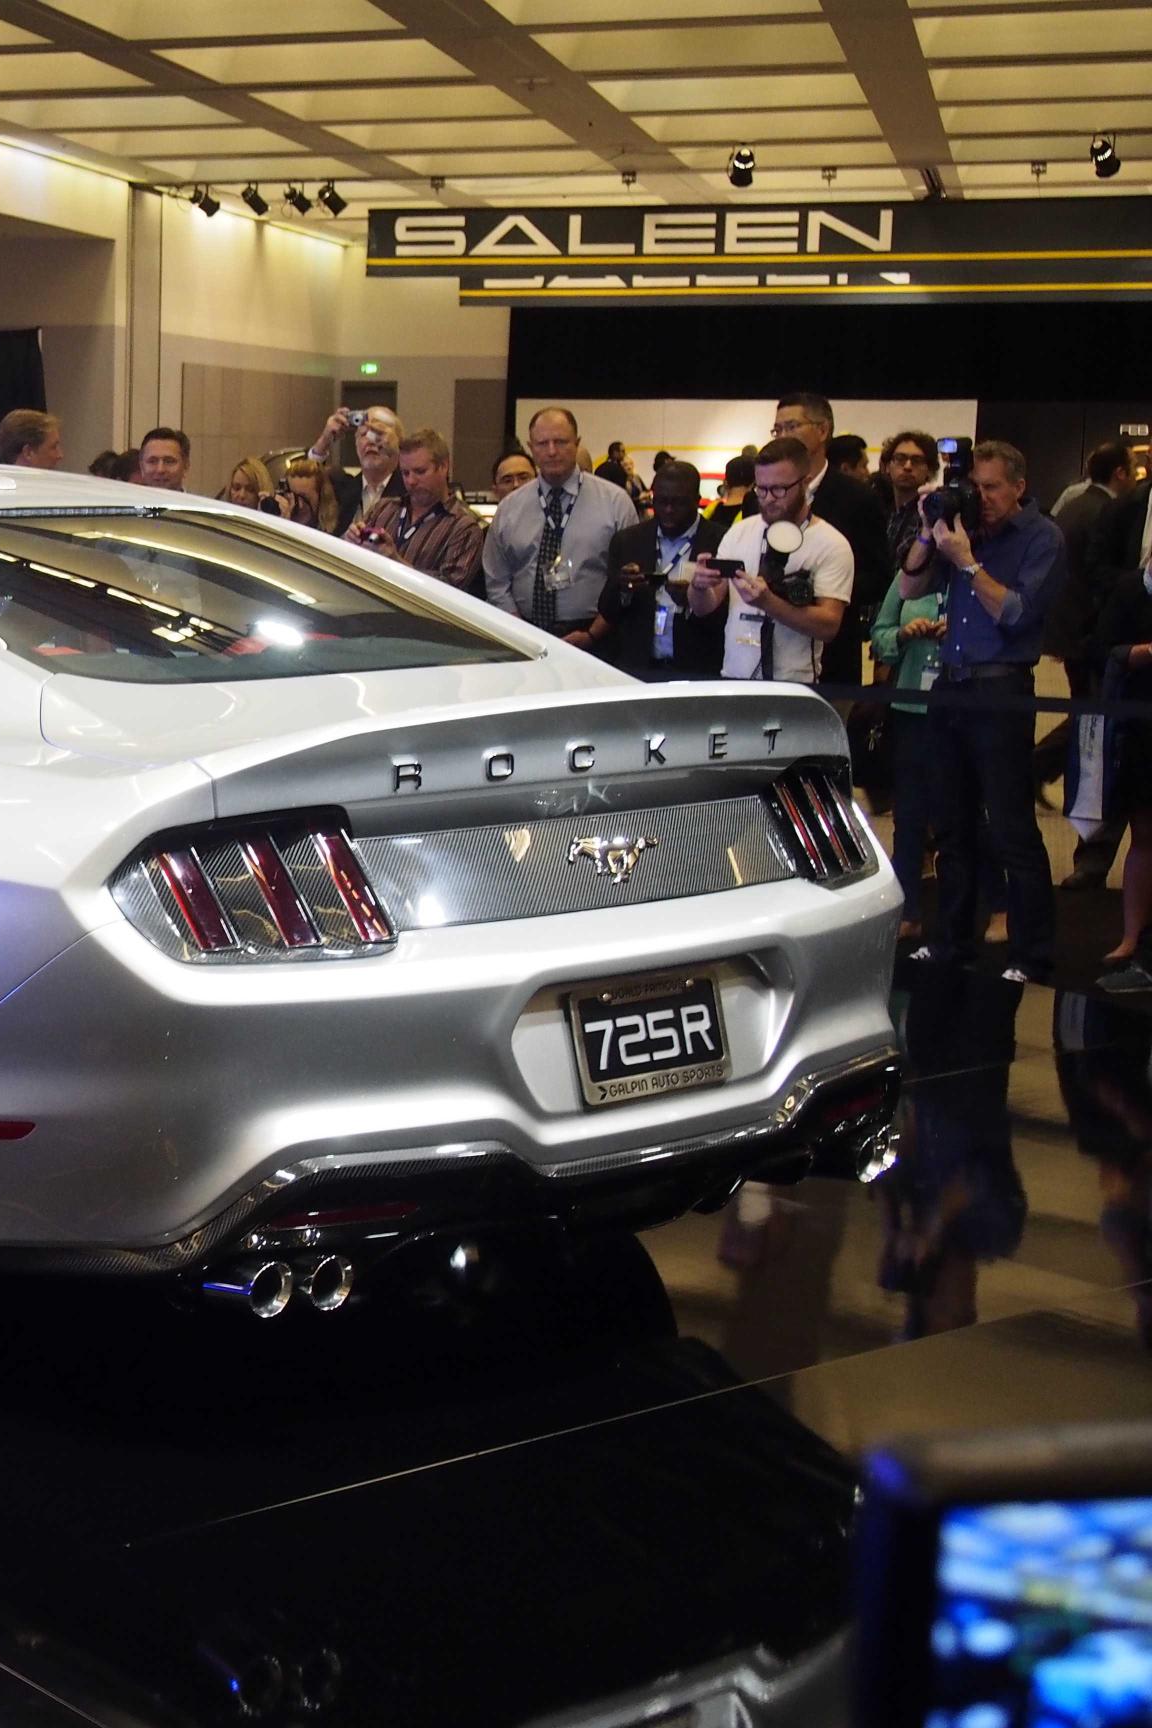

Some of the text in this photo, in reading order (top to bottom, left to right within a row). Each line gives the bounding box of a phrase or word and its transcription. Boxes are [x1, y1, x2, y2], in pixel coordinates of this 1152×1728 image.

[395, 209, 893, 257] SALEEN
[391, 725, 782, 793] ROCKET
[584, 1004, 715, 1070] 725R
[609, 1064, 724, 1097] GALPIN AUTO SPORTS
